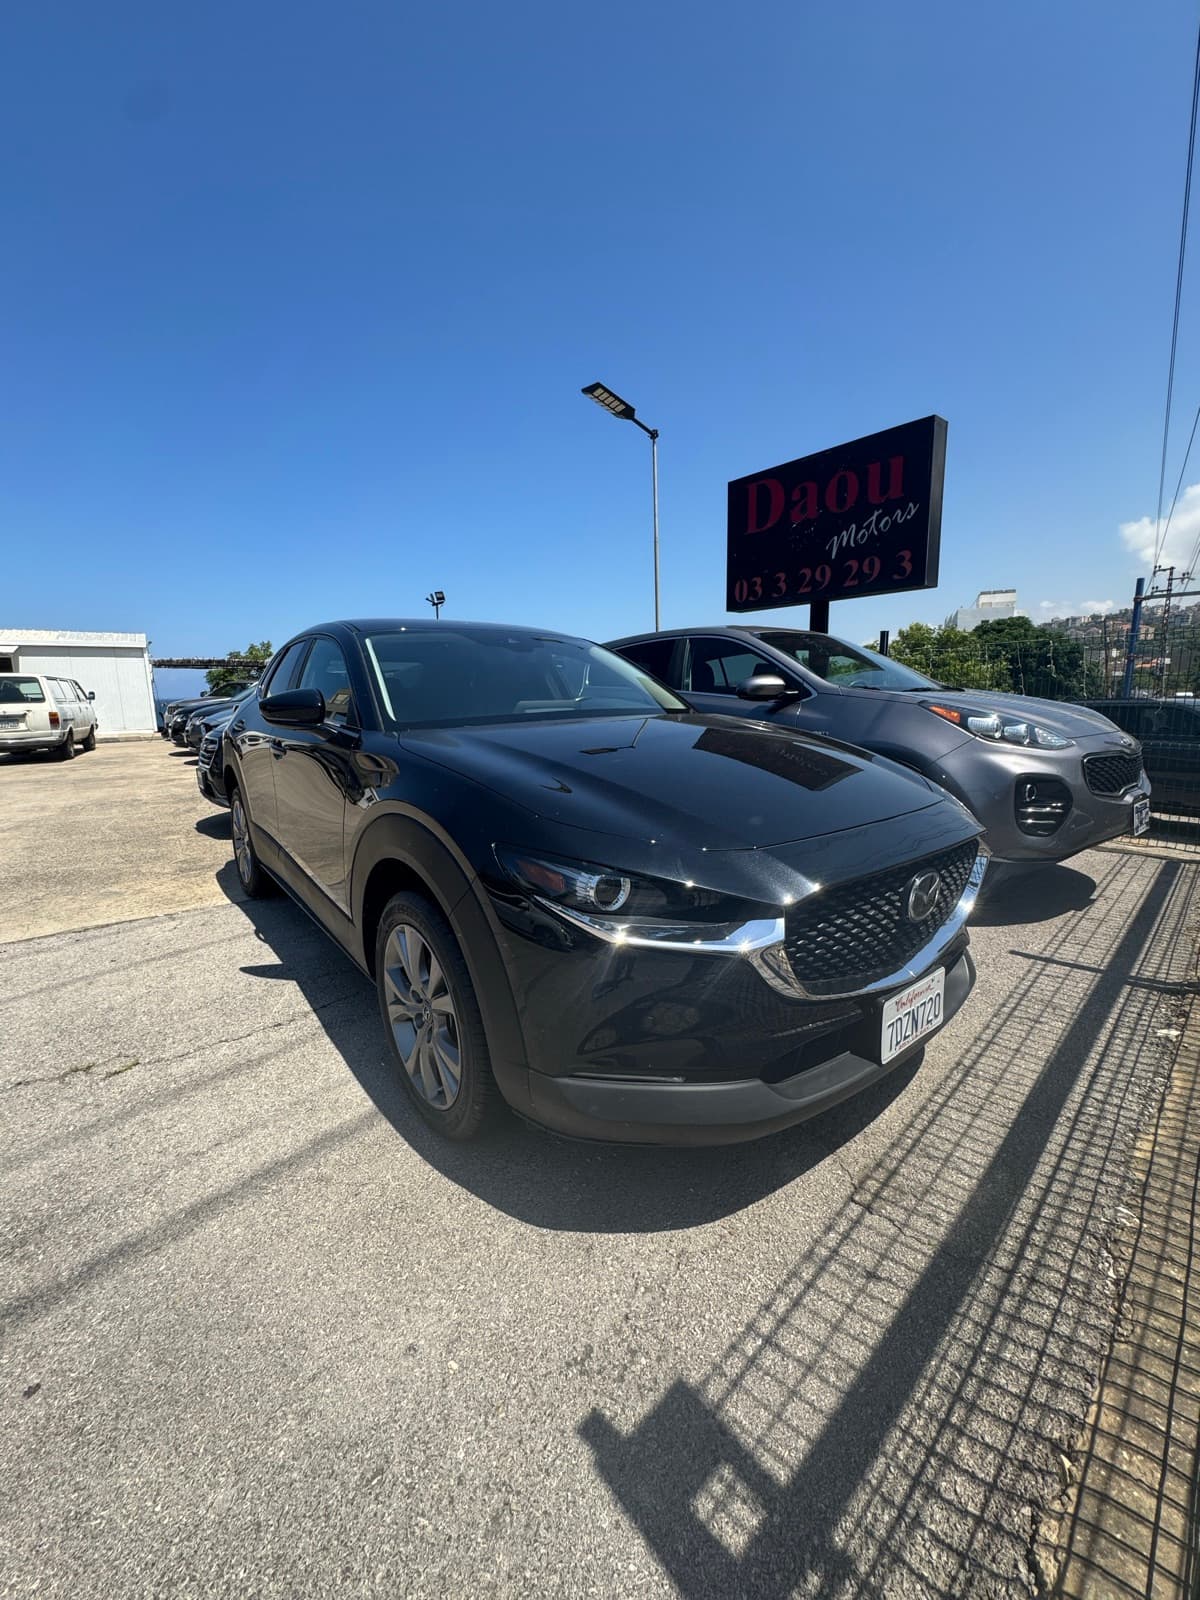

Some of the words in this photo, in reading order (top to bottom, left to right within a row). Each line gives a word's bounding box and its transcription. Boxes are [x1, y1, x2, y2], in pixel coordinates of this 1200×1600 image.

[744, 455, 905, 535] Daou
[826, 502, 920, 559] Motors
[734, 577, 763, 602] 03
[772, 572, 787, 597] 3
[797, 564, 832, 594] 29
[843, 556, 881, 586] 29
[893, 549, 913, 580] 3
[887, 991, 941, 1052] 7DZN720
